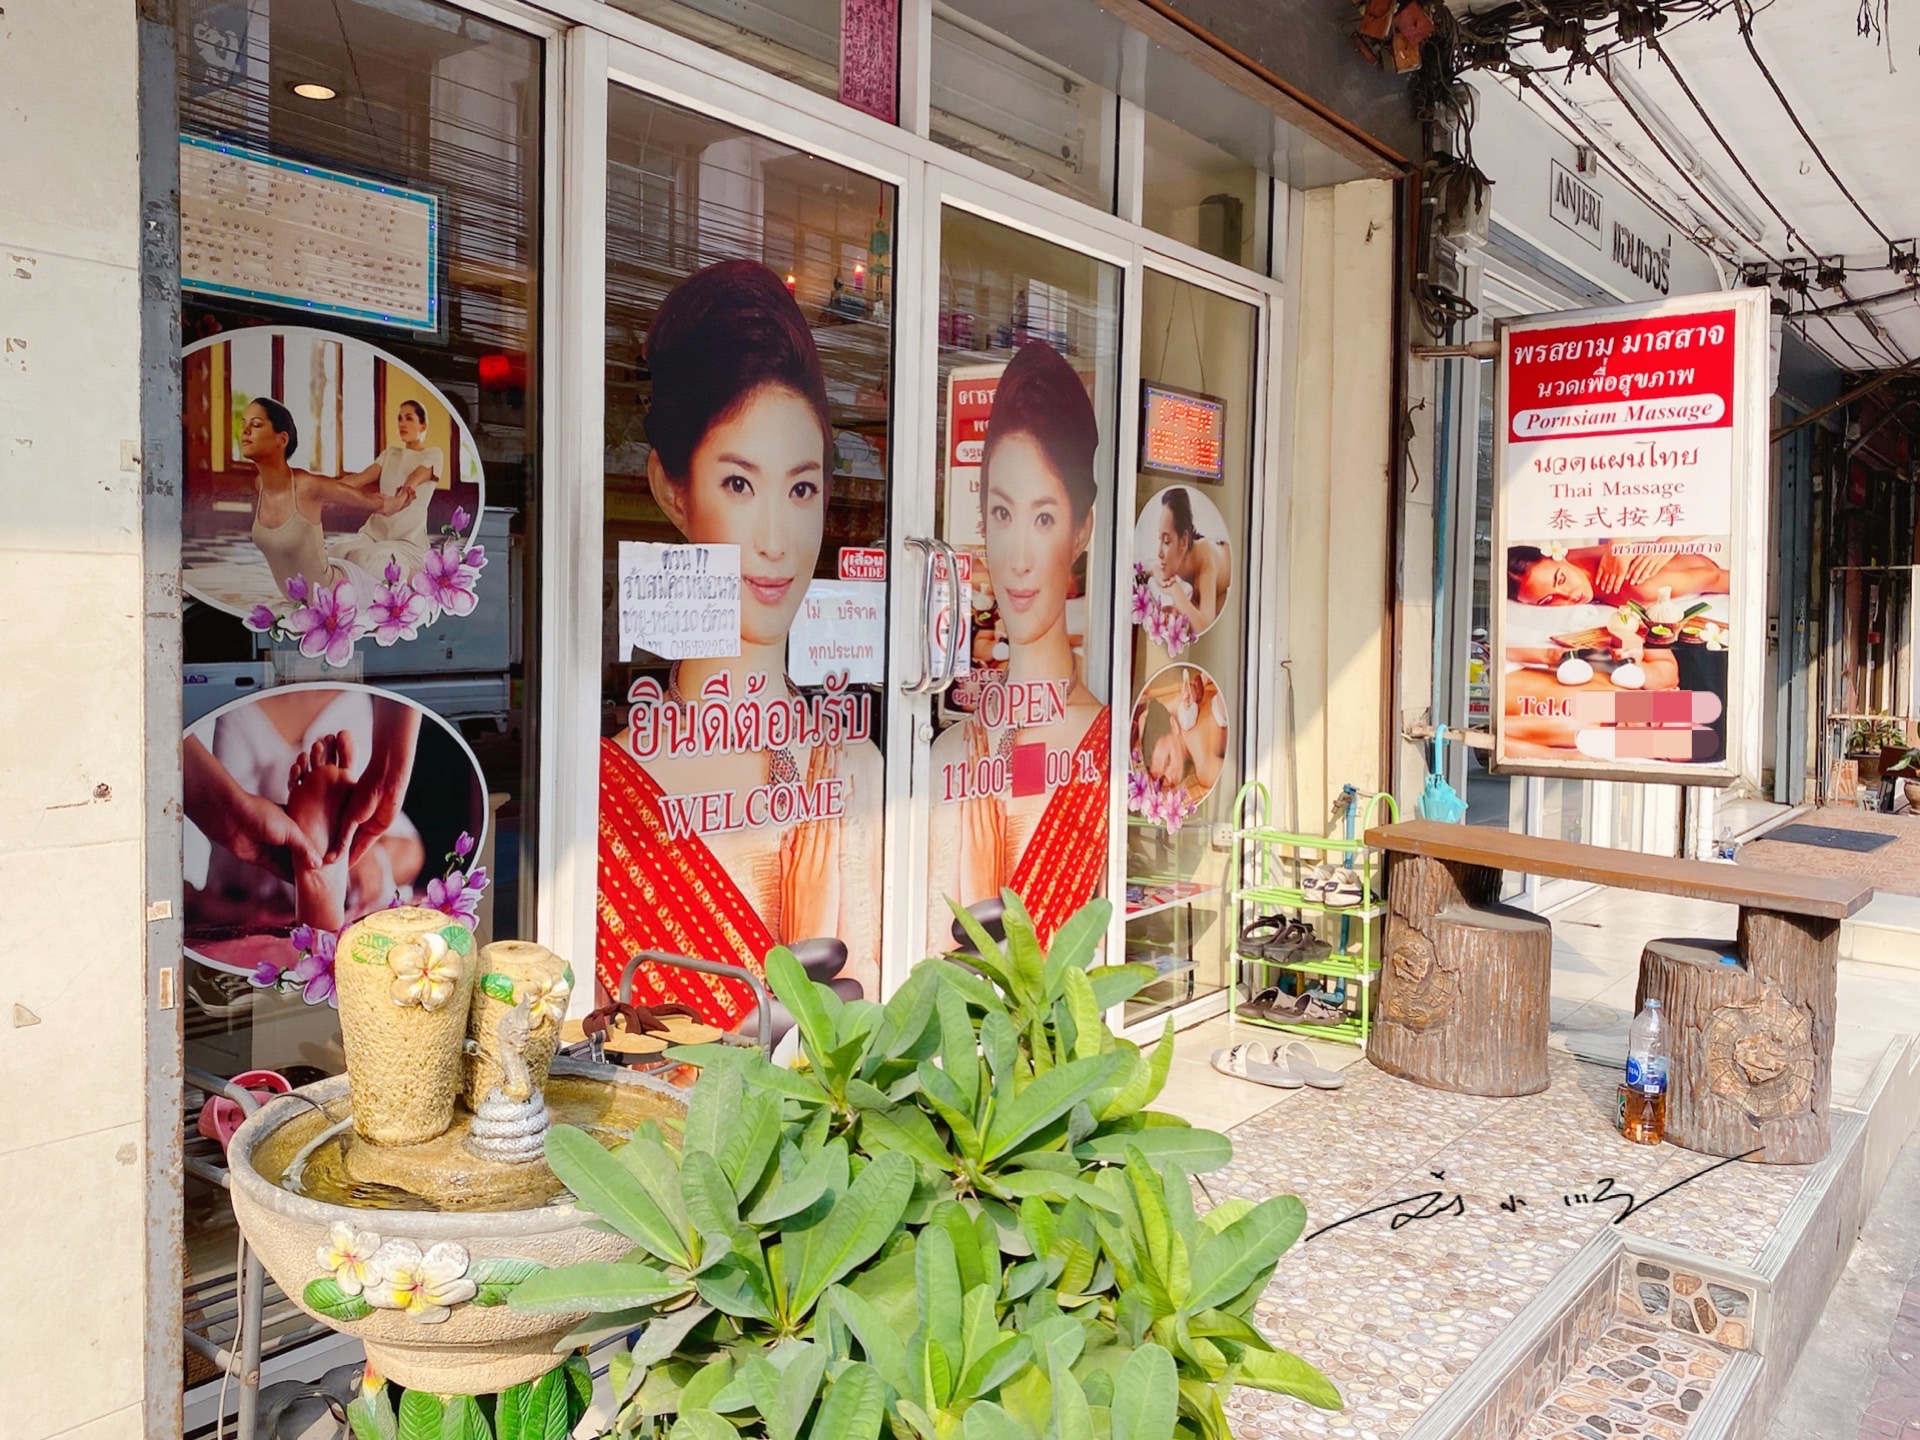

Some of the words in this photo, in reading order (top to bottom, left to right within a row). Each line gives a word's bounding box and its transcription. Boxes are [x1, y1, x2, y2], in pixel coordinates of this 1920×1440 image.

[208, 161, 400, 245] OPEN
[1555, 171, 1602, 232] ANJERI
[1514, 336, 1615, 366] พรสยาม
[1621, 324, 1725, 354] มาสสาจ
[1537, 357, 1696, 398] นวดเพื่อสุขภาพ
[1159, 399, 1214, 435] OPEN
[1525, 409, 1617, 431] Pornsiam
[1623, 402, 1713, 424] Massage
[1533, 440, 1700, 476] นวดแผนไทย
[1549, 481, 1593, 499] Thai
[1601, 480, 1686, 500] Massage
[1547, 502, 1686, 531] 泰式按摩
[1611, 541, 1723, 556] พรสยามมาสสาจ
[849, 566, 884, 578] SLIDE
[808, 639, 874, 667] ทุกประเภท
[629, 670, 870, 759] ยินดีต้อนรับ
[980, 680, 1069, 728] OPEN
[659, 780, 845, 840] WELCOME
